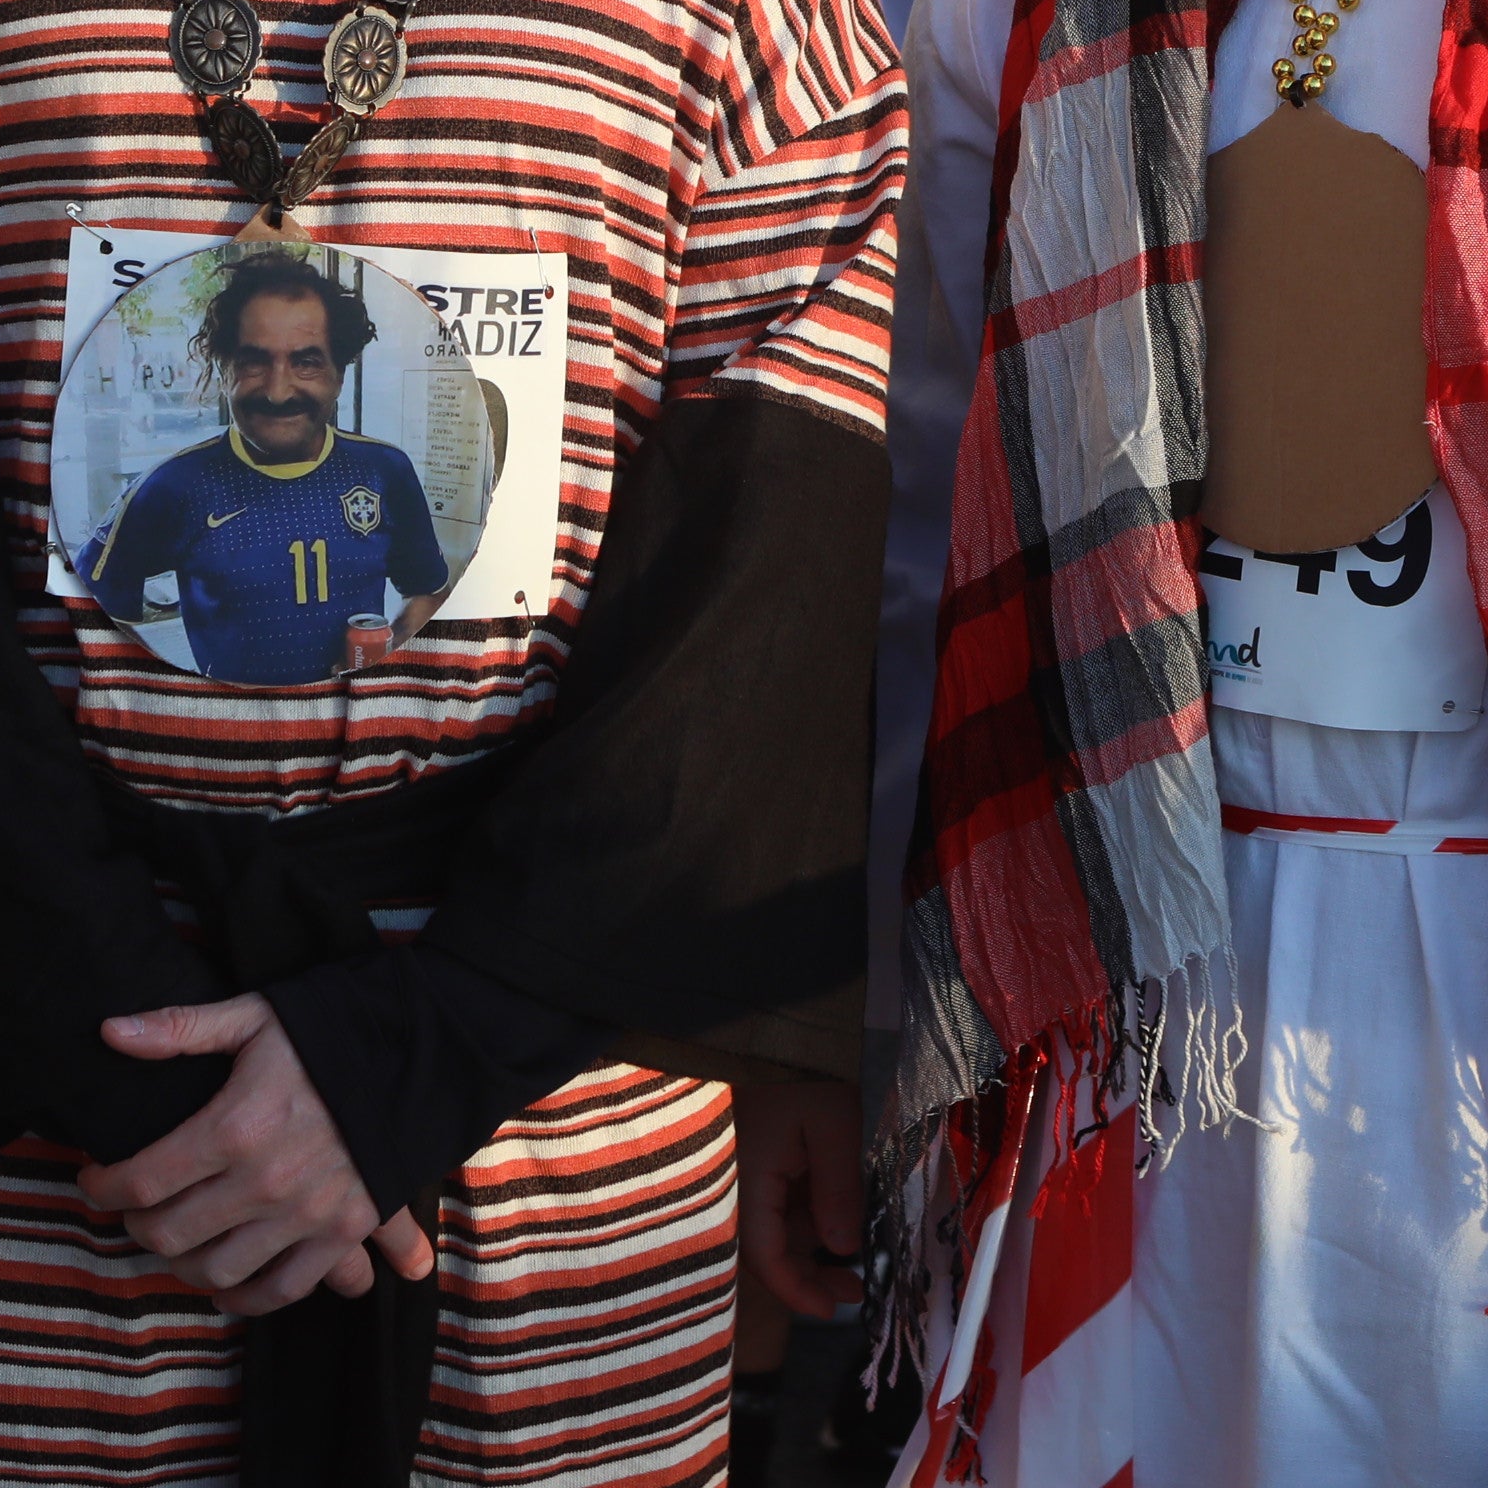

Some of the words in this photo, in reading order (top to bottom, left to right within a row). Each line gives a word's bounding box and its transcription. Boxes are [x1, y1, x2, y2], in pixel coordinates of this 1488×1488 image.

[416, 284, 545, 316] STRE
[288, 539, 329, 605] 11
[1207, 625, 1262, 668] md
